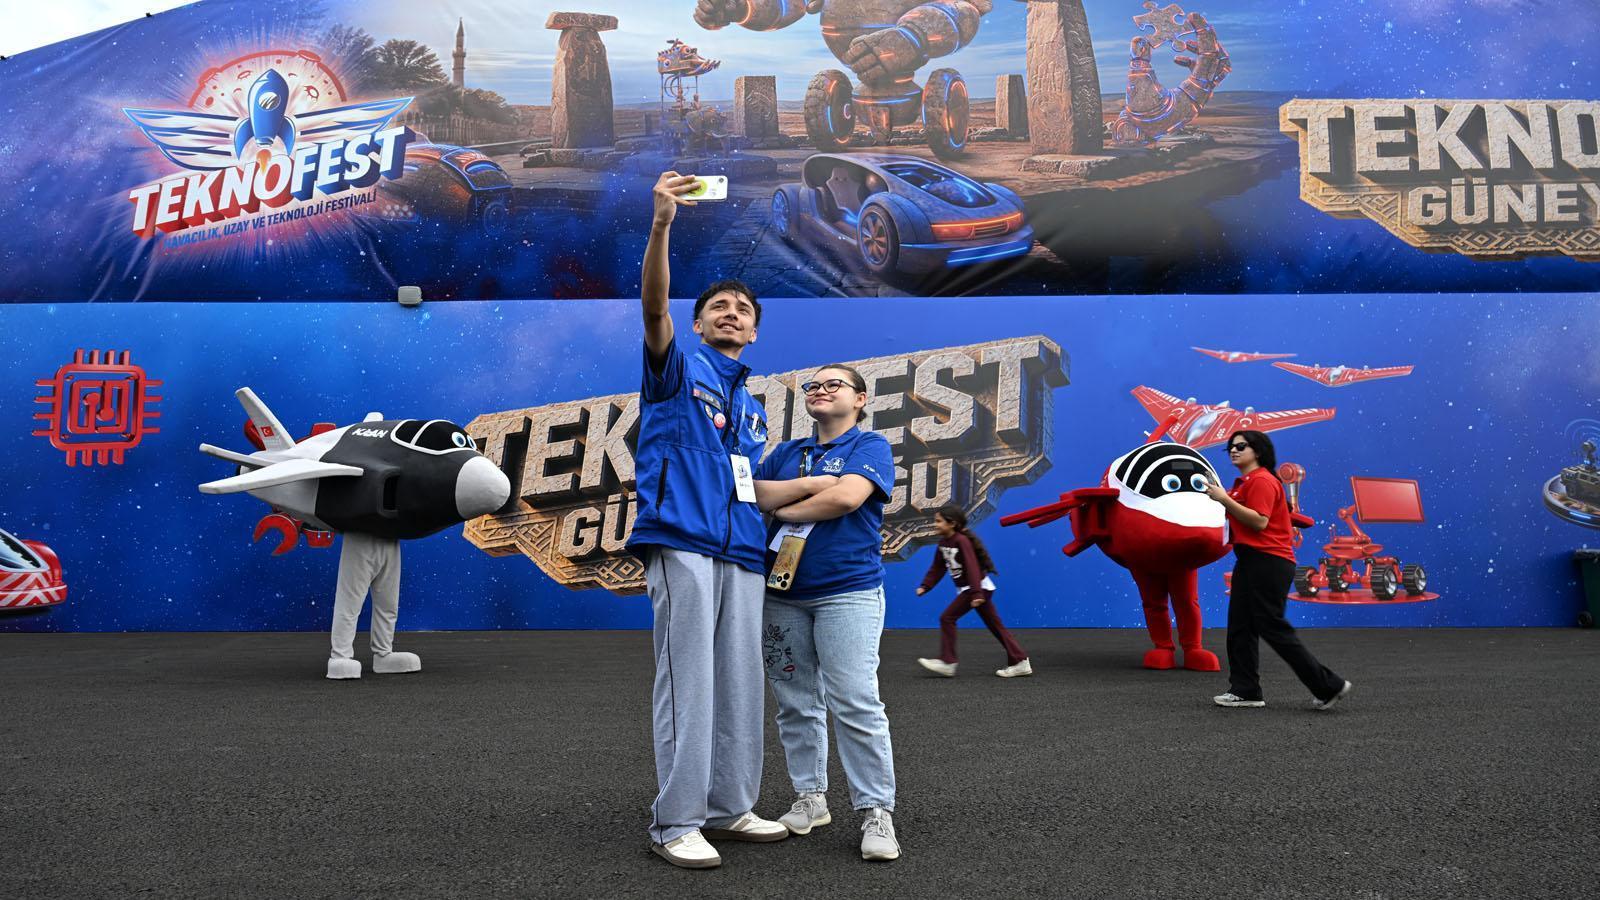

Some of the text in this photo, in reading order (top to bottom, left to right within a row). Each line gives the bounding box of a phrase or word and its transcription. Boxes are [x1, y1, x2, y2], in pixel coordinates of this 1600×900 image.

[1287, 102, 1600, 174] TEKNO
[128, 125, 406, 232] TEKNOFEST
[223, 219, 250, 236] UZAY
[252, 215, 266, 230] VE
[267, 200, 324, 226] TEKNOLOJİ
[325, 188, 377, 213] FESTİVALİ
